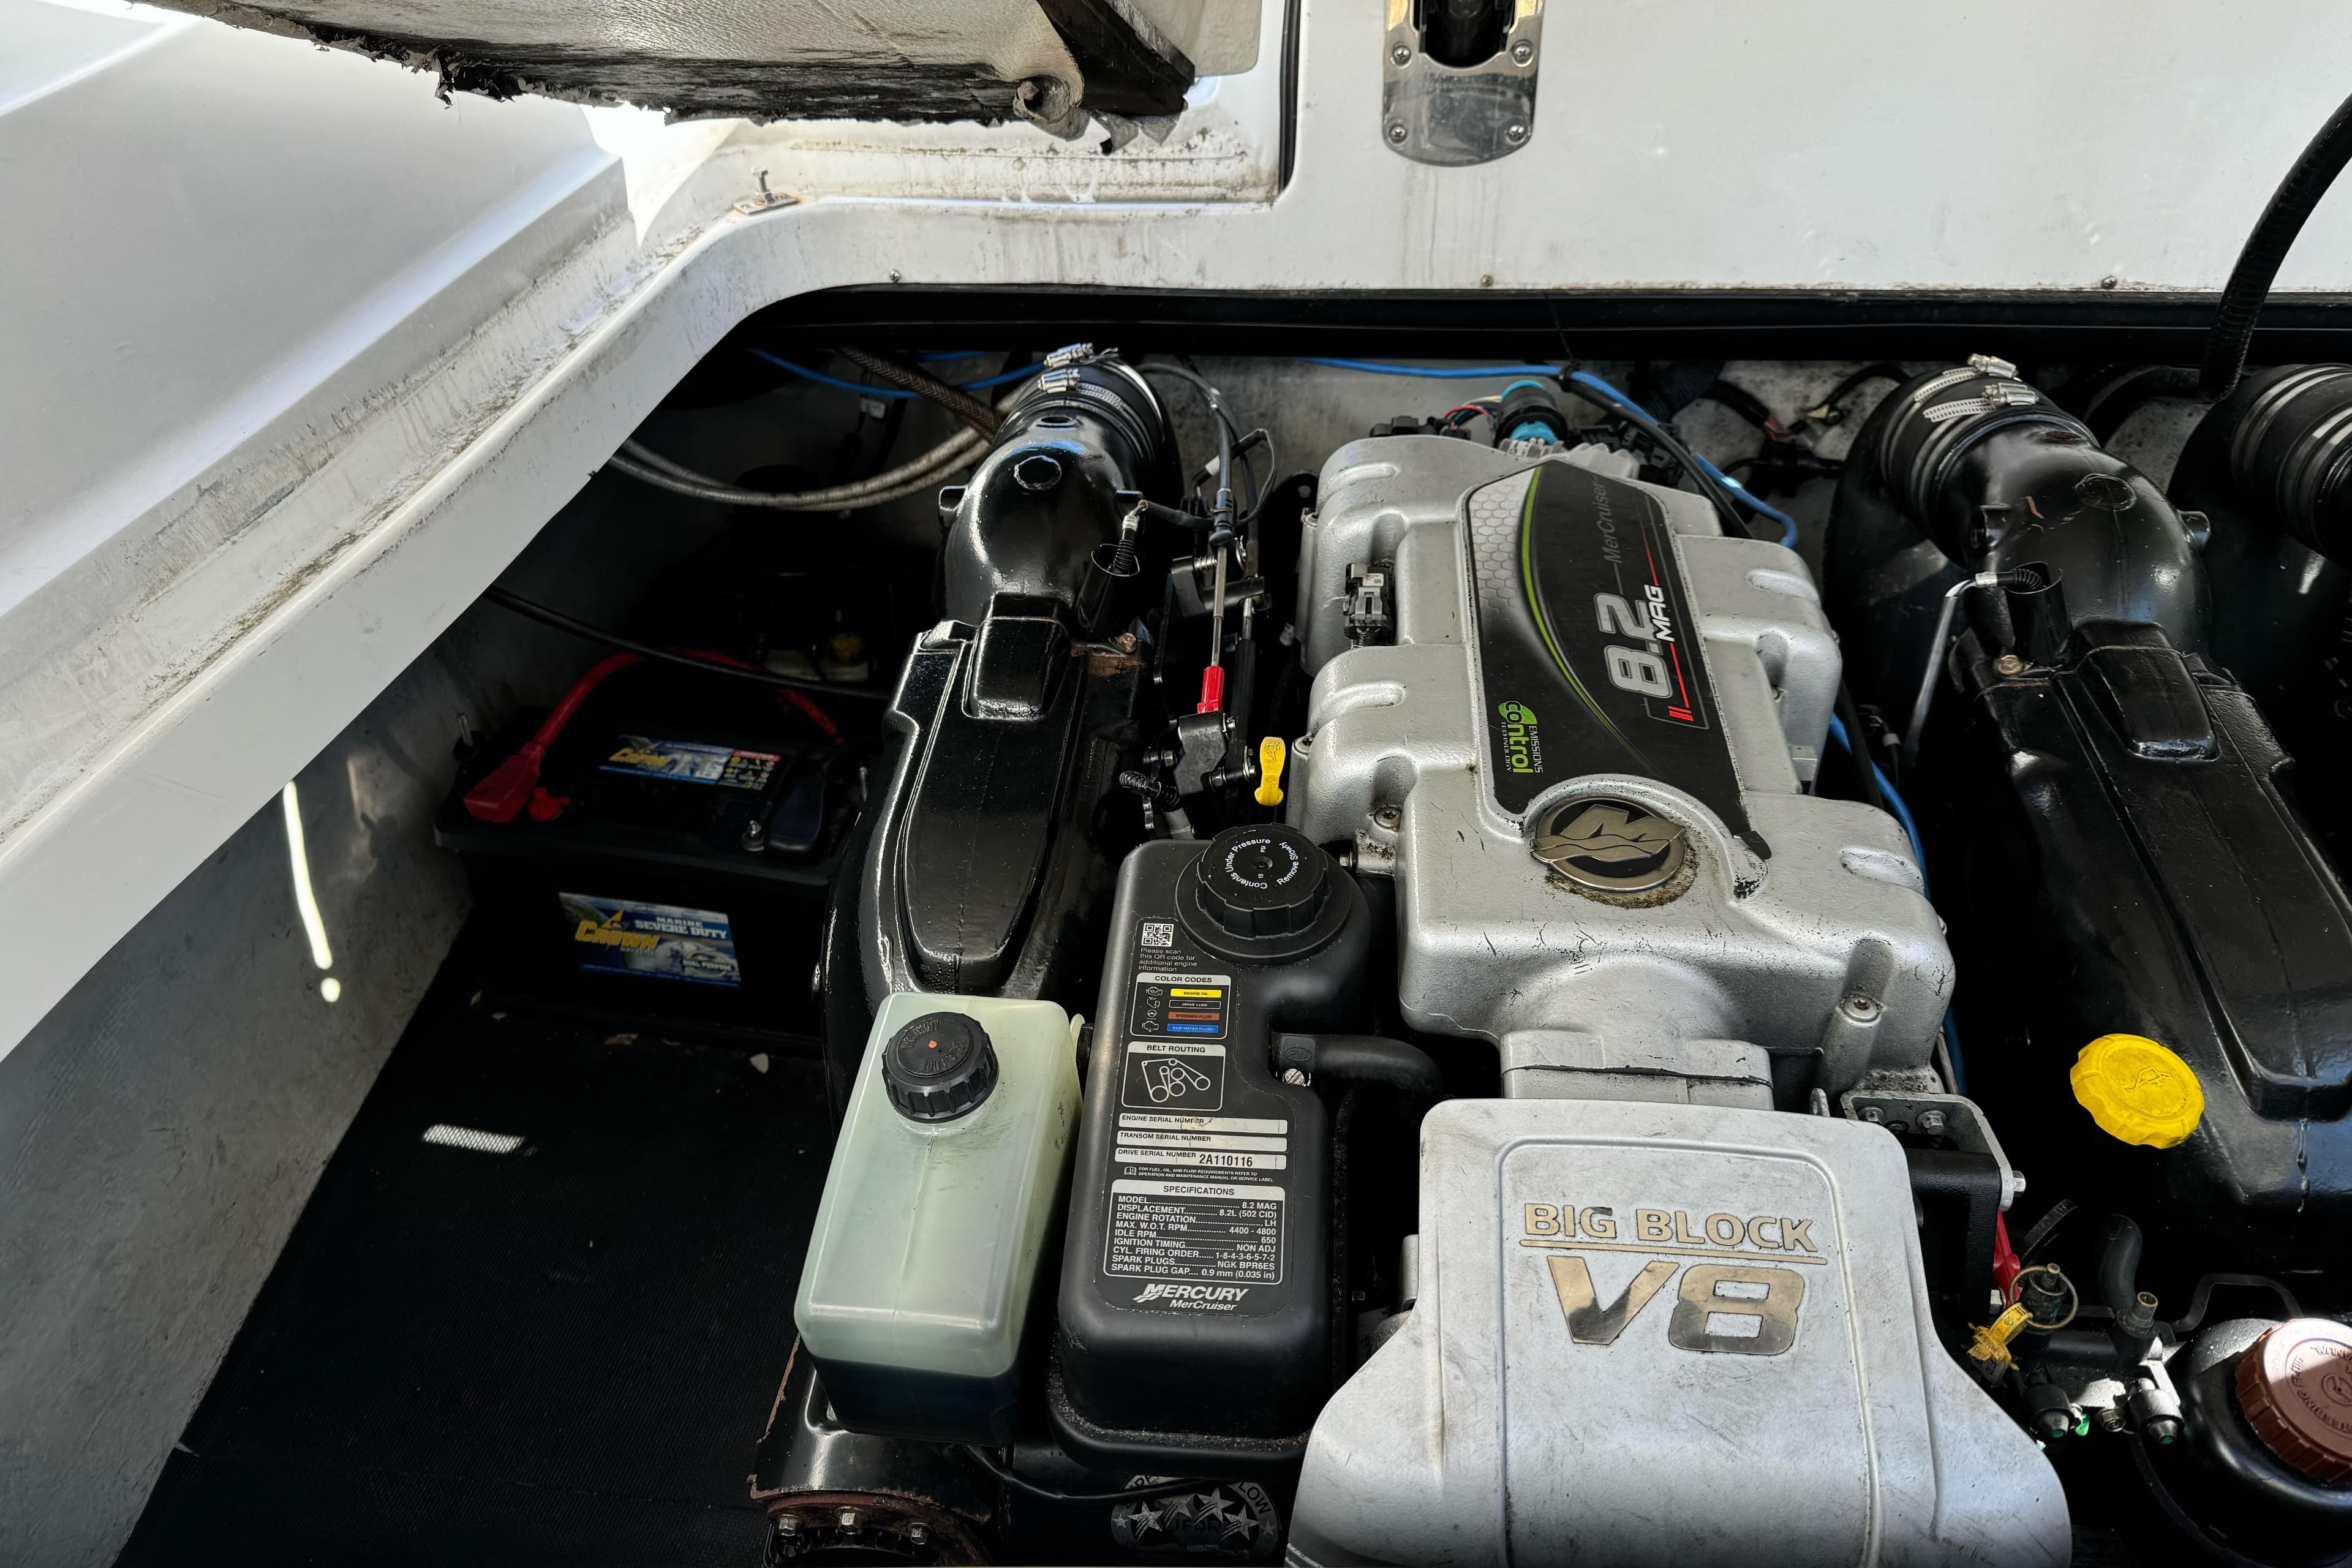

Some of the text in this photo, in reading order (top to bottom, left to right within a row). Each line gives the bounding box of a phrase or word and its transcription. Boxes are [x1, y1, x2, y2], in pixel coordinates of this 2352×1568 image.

[1591, 481, 1623, 564] MerCruiser
[1644, 584, 1675, 642] MAG
[1594, 592, 1673, 699] 8.2
[1505, 700, 1534, 773] control
[1529, 725, 1544, 773] EMISSIONS
[1225, 839, 1272, 889] Contents Under Pressure
[1276, 842, 1299, 885] Remove Slowly
[633, 919, 728, 940] SEVERE DUTY
[655, 916, 704, 929] MARINE
[1199, 1154, 1253, 1167] 2A110116
[1118, 1195, 1150, 1204] MODEL
[1163, 1185, 1235, 1195] SPECIFICATIONS
[1117, 1204, 1186, 1214] DISPLACEMENT
[1239, 1210, 1256, 1218] (502
[1259, 1211, 1276, 1219] CID)
[1117, 1212, 1150, 1221] ENGINE
[1152, 1214, 1196, 1223] ROTATION
[1140, 1222, 1166, 1231] W.O.T.
[1524, 1202, 1818, 1253] BIG BLOCK
[1114, 1237, 1153, 1246] IGNITION
[1155, 1240, 1186, 1248] TIMING
[1112, 1254, 1142, 1263] SPARK
[1145, 1257, 1175, 1265] PLUGS
[1167, 1249, 1199, 1257] ORDER
[1215, 1252, 1275, 1261] 1-8-4-3-6-5-7-2
[1111, 1263, 1141, 1272] SPARK
[1144, 1265, 1168, 1274] PLUG
[1235, 1270, 1261, 1279] (0.035
[1263, 1271, 1275, 1281] in)
[1133, 1283, 1250, 1303] MERCURY
[1169, 1299, 1237, 1311] MerCruiser
[1547, 1254, 1805, 1355] V8
[1238, 1480, 1271, 1513] LOW
